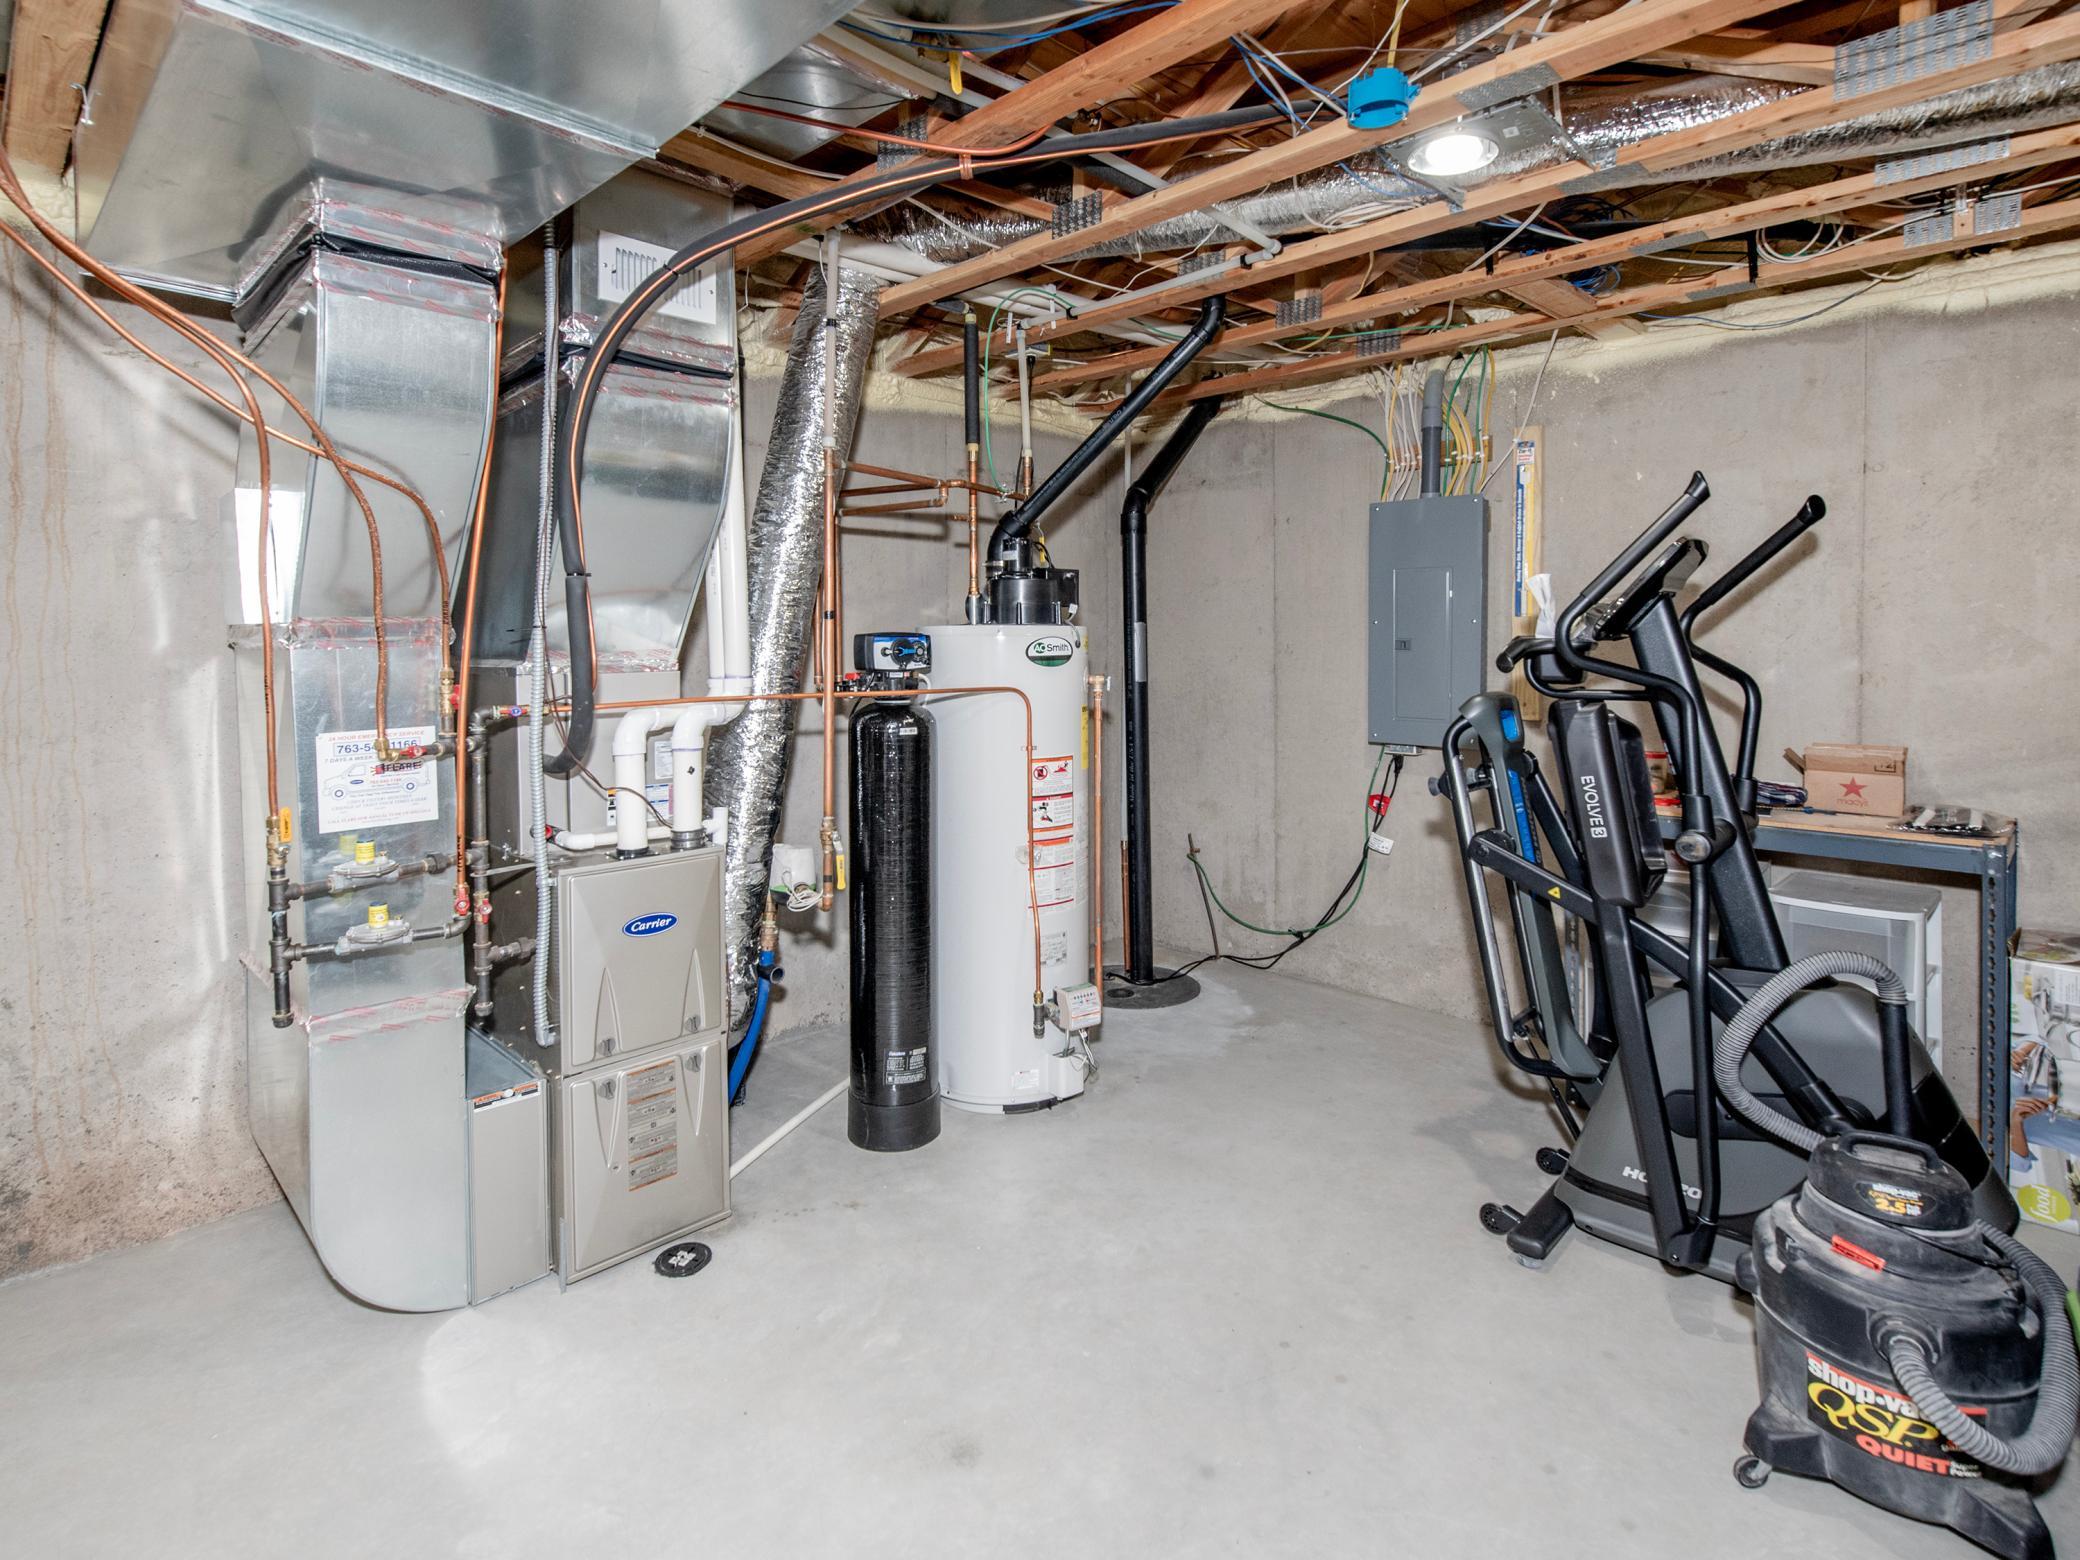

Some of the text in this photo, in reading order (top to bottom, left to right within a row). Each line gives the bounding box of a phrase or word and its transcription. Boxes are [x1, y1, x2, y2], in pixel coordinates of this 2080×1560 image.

[1046, 643, 1070, 652] Smith
[386, 760, 422, 772] FLARE
[1580, 775, 1604, 826] EVOLVE
[631, 917, 672, 932] Carrier
[1855, 1434, 1951, 1477] QUIET
